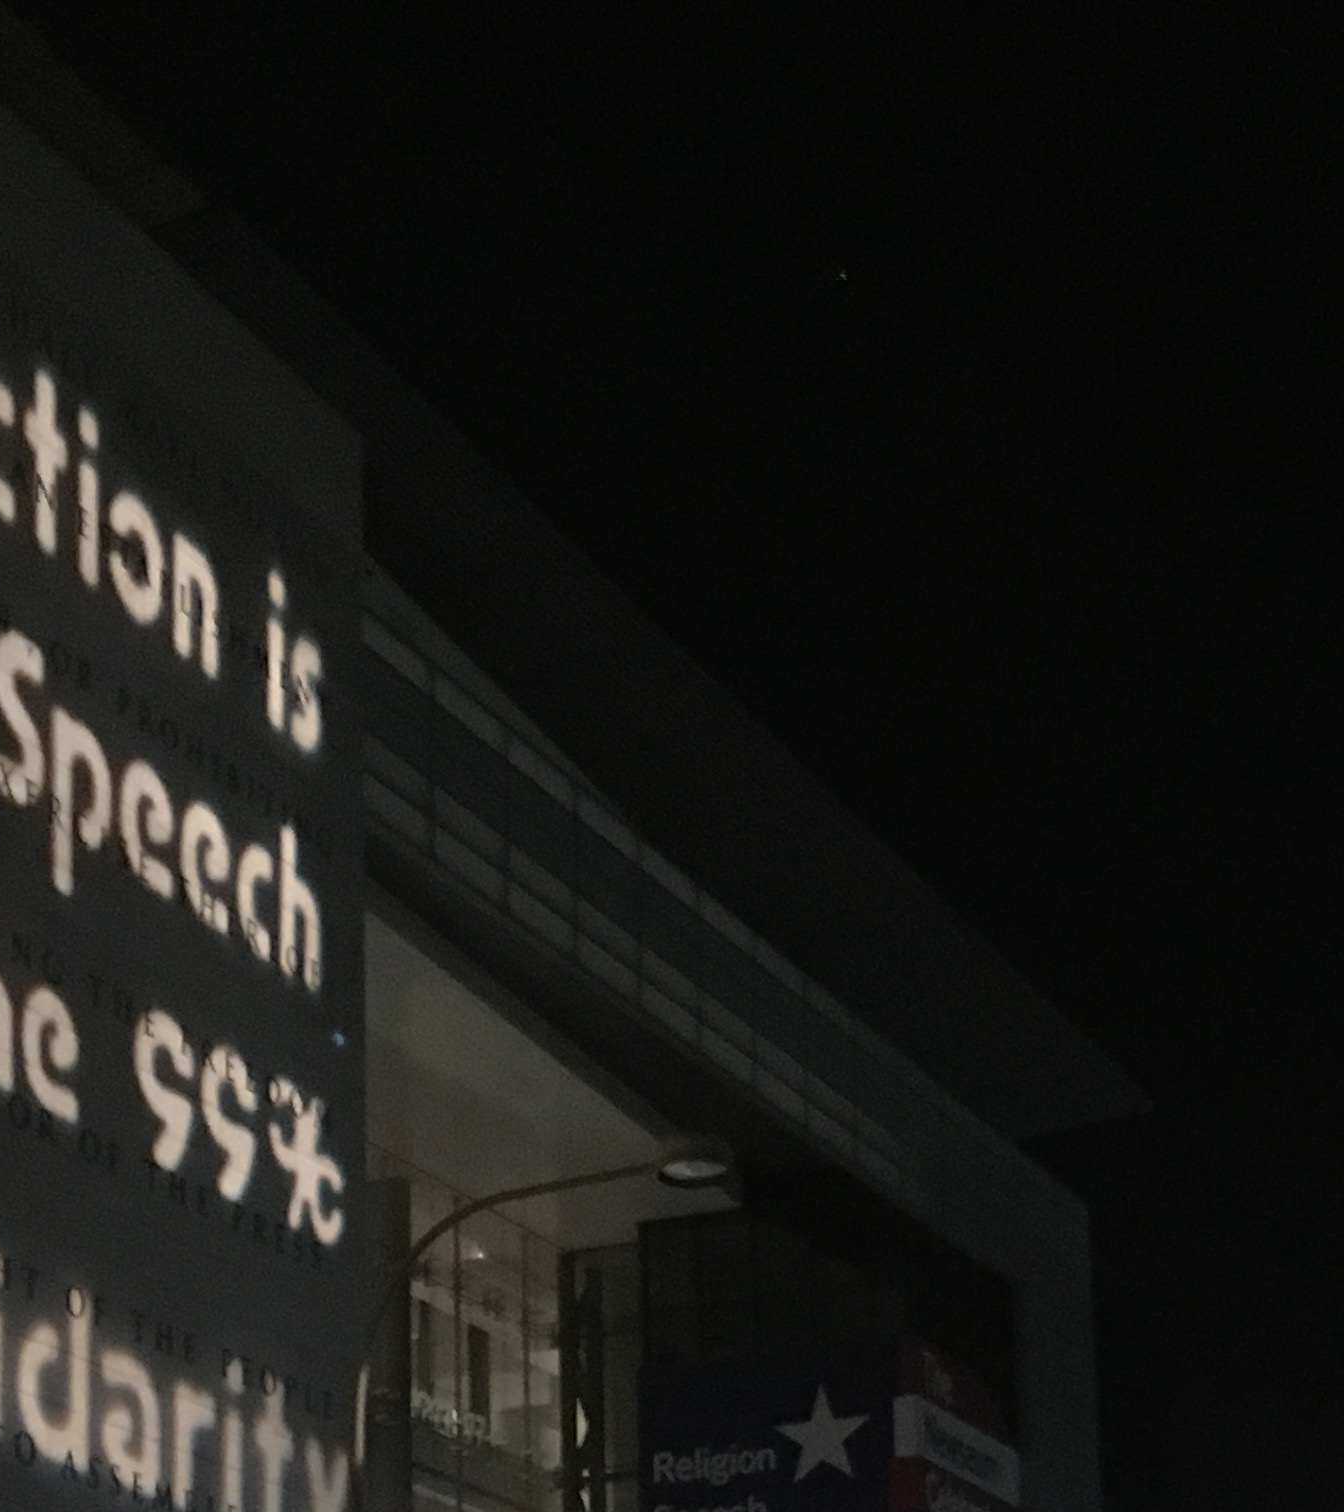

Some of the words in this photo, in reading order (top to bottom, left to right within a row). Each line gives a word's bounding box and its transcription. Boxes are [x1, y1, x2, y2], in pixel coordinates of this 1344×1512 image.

[264, 562, 327, 754] is
[131, 1006, 348, 1250] 99%
[652, 1444, 778, 1486] Religion
